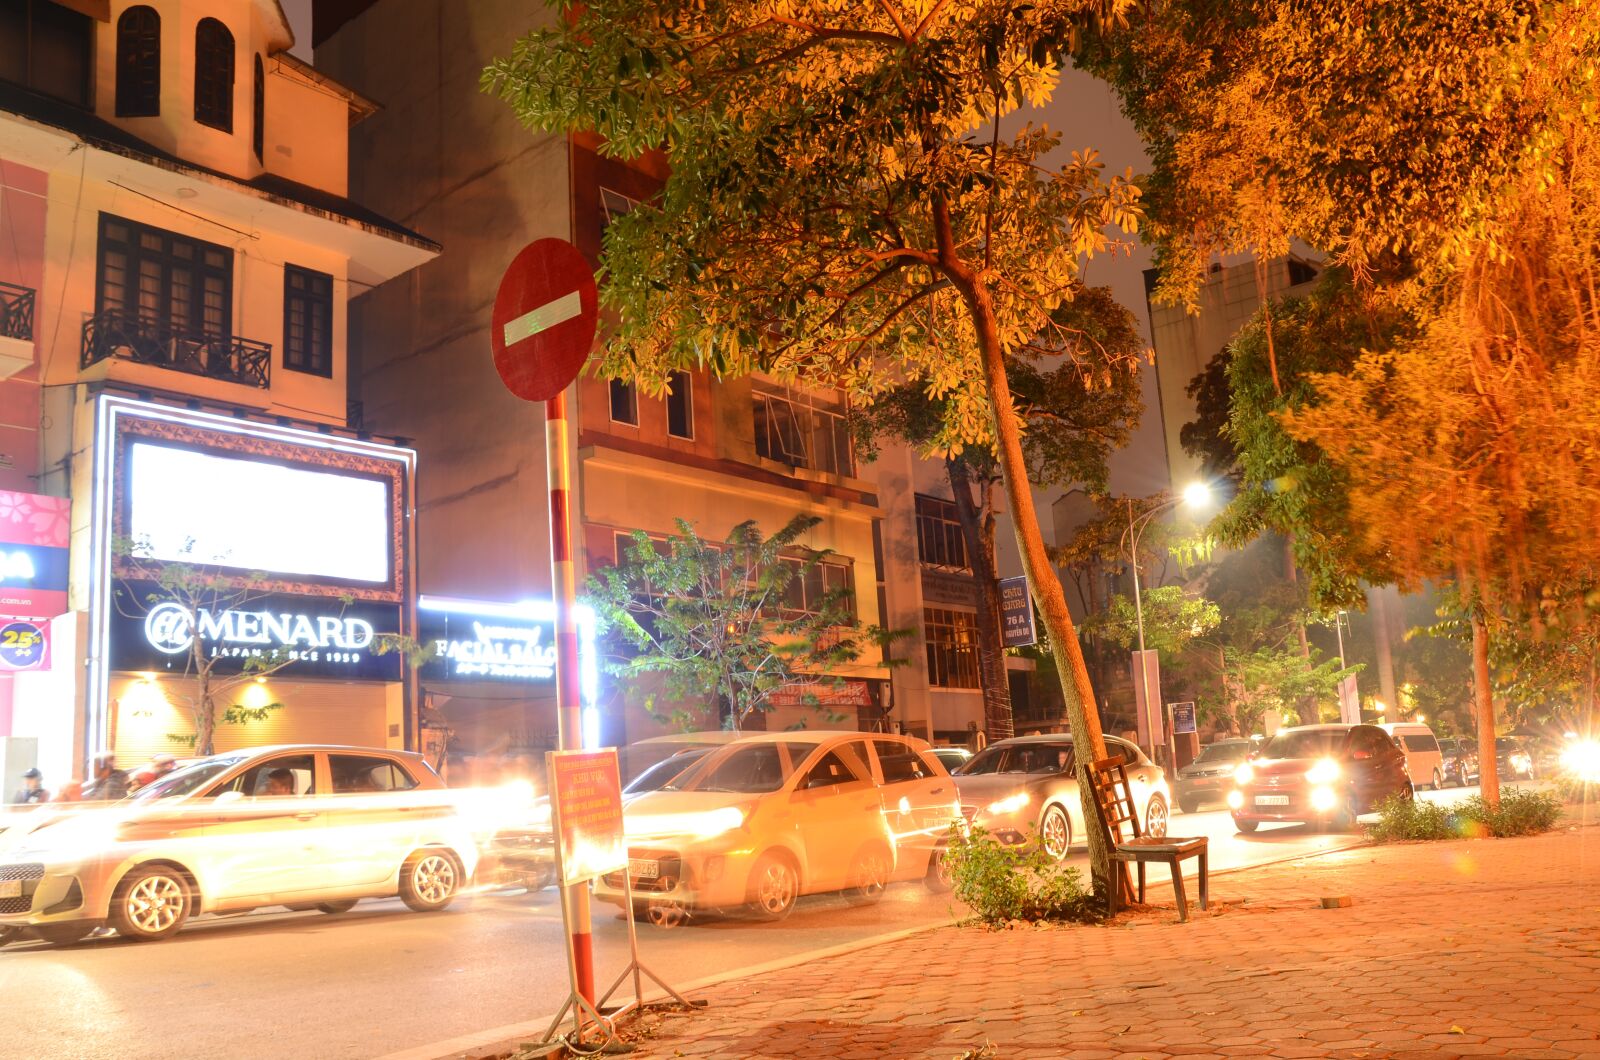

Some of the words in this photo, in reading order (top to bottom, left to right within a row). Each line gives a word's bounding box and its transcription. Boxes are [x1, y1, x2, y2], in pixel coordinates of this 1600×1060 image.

[197, 607, 374, 649] MENARD
[1007, 616, 1017, 625] 76
[1018, 614, 1025, 624] A
[271, 648, 319, 662] SNCE
[326, 652, 360, 663] 1959
[435, 639, 509, 662] FACIAL
[510, 643, 556, 666] SALO
